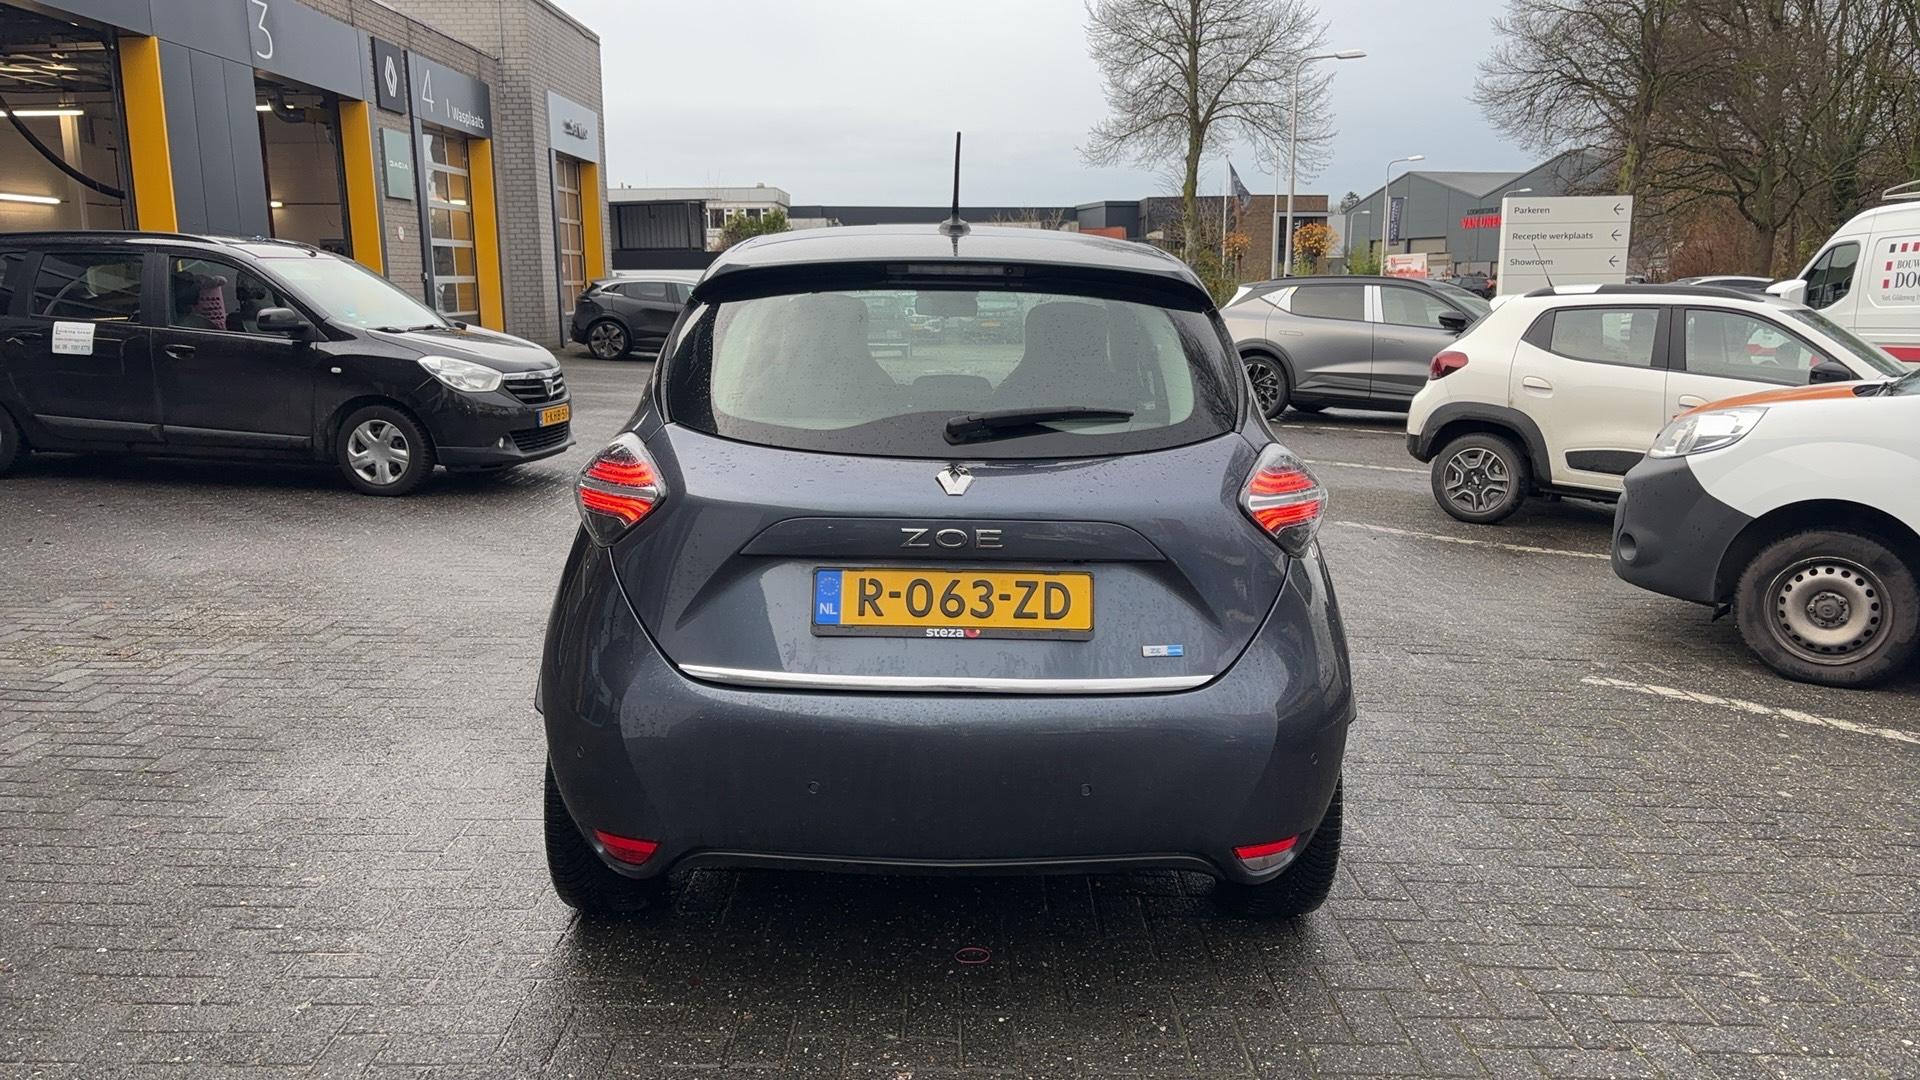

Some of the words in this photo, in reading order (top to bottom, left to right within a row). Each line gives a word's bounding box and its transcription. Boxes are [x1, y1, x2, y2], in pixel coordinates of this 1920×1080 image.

[252, 0, 273, 59] 3
[422, 69, 435, 112] 4
[451, 104, 484, 129] Wasplaats
[1514, 206, 1550, 214] Parkeren
[1512, 232, 1547, 241] Receptie
[1549, 232, 1593, 240] werkplaats
[1510, 258, 1553, 266] Showroom
[1894, 271, 1920, 289] DO
[900, 528, 1003, 549] ZOE
[858, 578, 1071, 620] R-063-ZD
[819, 603, 837, 615] NL
[926, 627, 965, 638] steza
